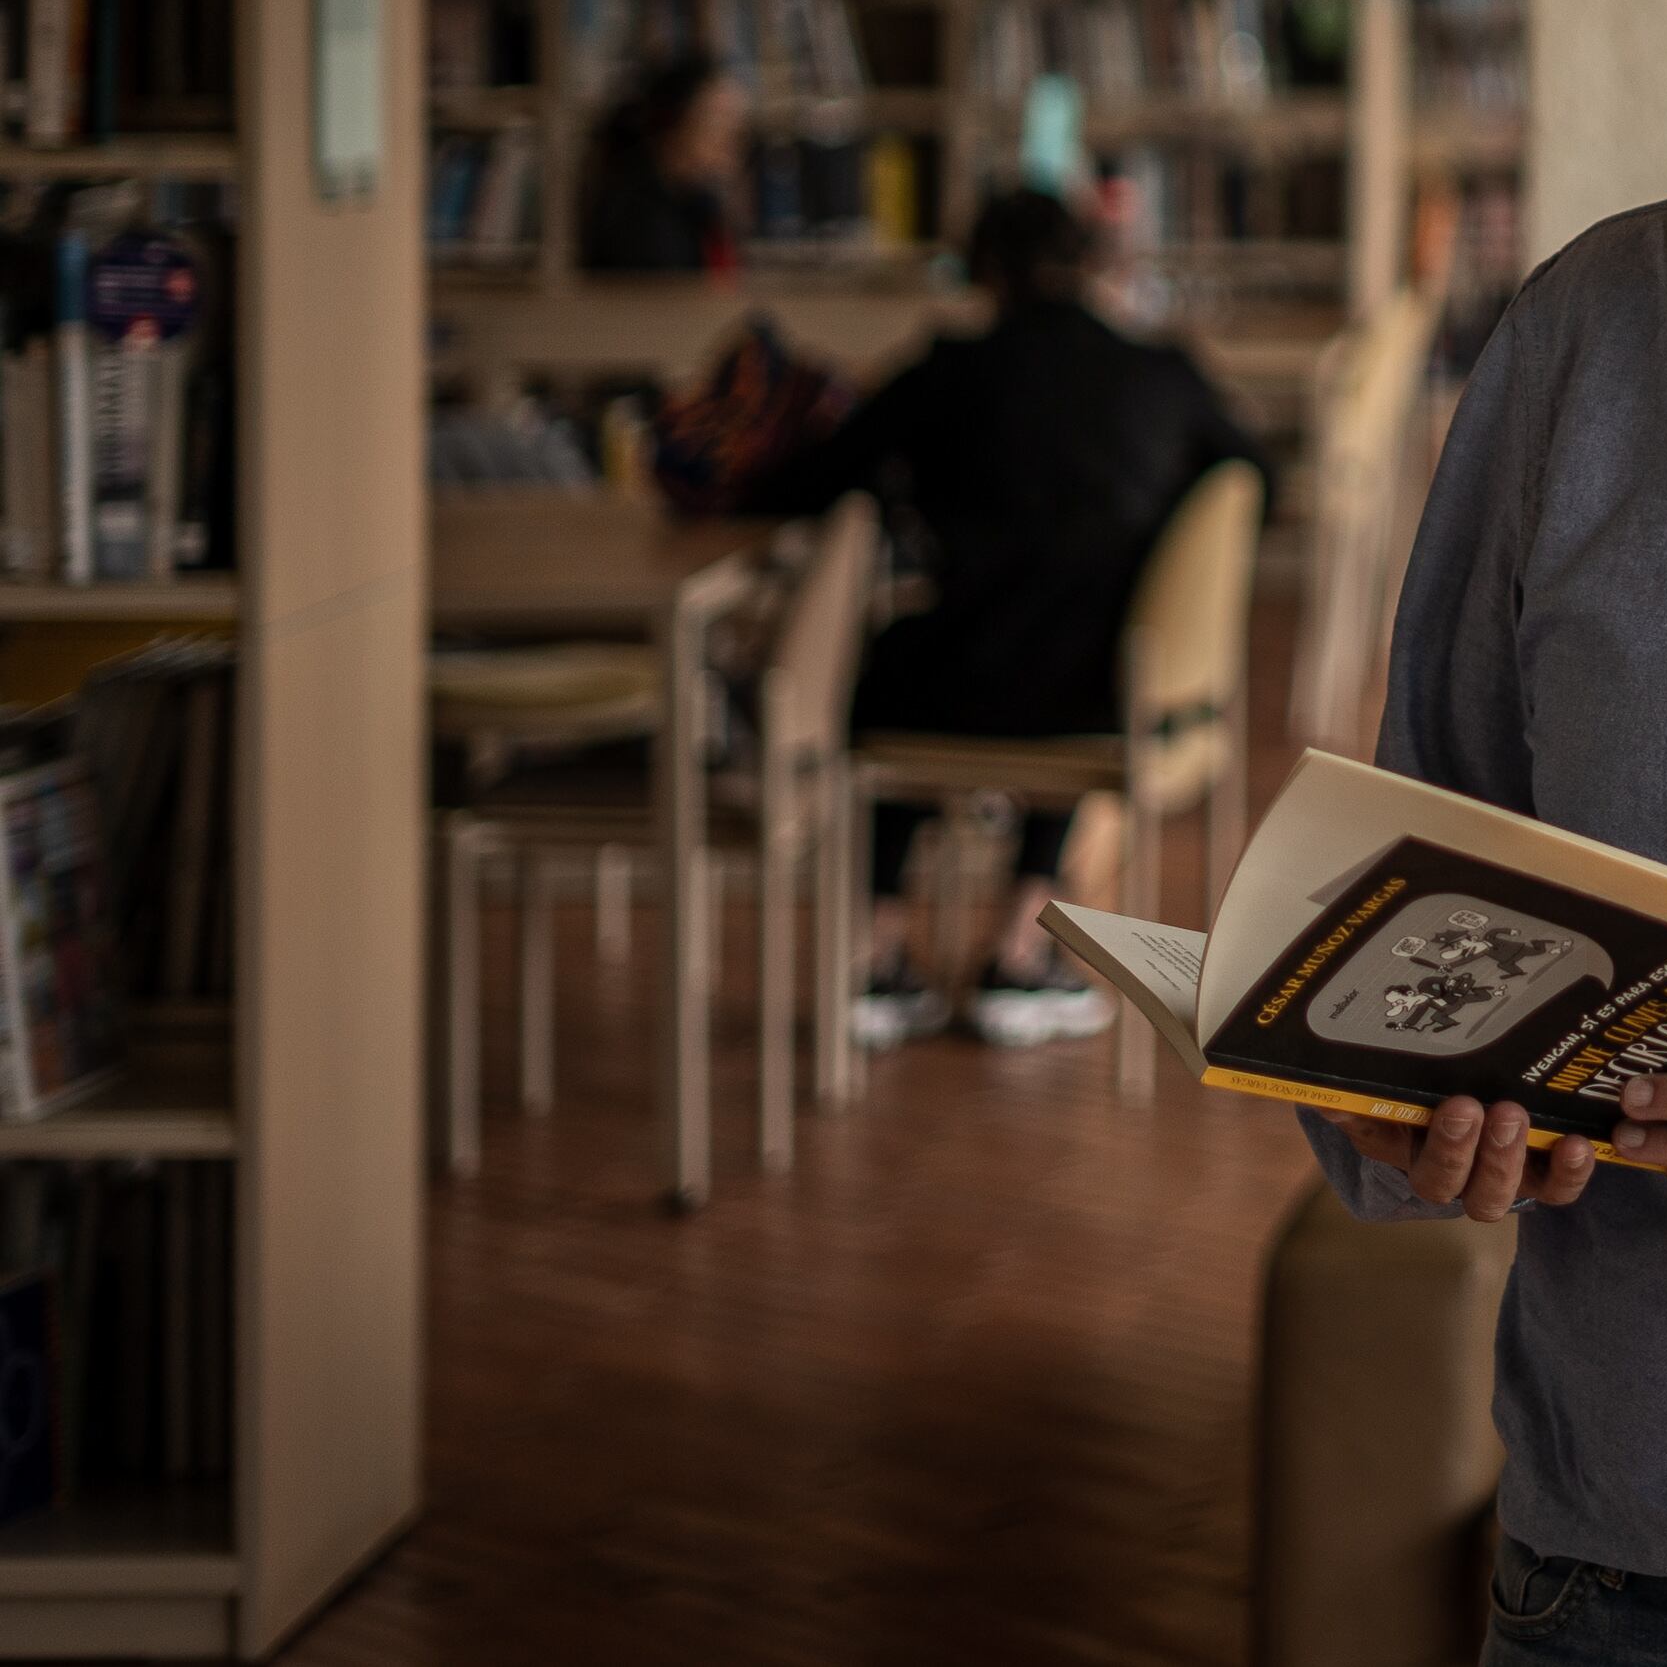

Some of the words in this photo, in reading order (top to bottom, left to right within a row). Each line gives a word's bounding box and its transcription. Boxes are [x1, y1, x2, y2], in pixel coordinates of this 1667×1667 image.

[1256, 977, 1304, 1025] CÉSAR
[1296, 926, 1354, 977] MUÑOZ
[1346, 877, 1407, 924] VARGAS
[1522, 1032, 1587, 1083] ¡VENGAN,
[1581, 1014, 1600, 1031] SÍ
[1596, 1003, 1616, 1018] ES
[1615, 980, 1652, 1006] PARA
[1546, 1044, 1617, 1092] NUEVE
